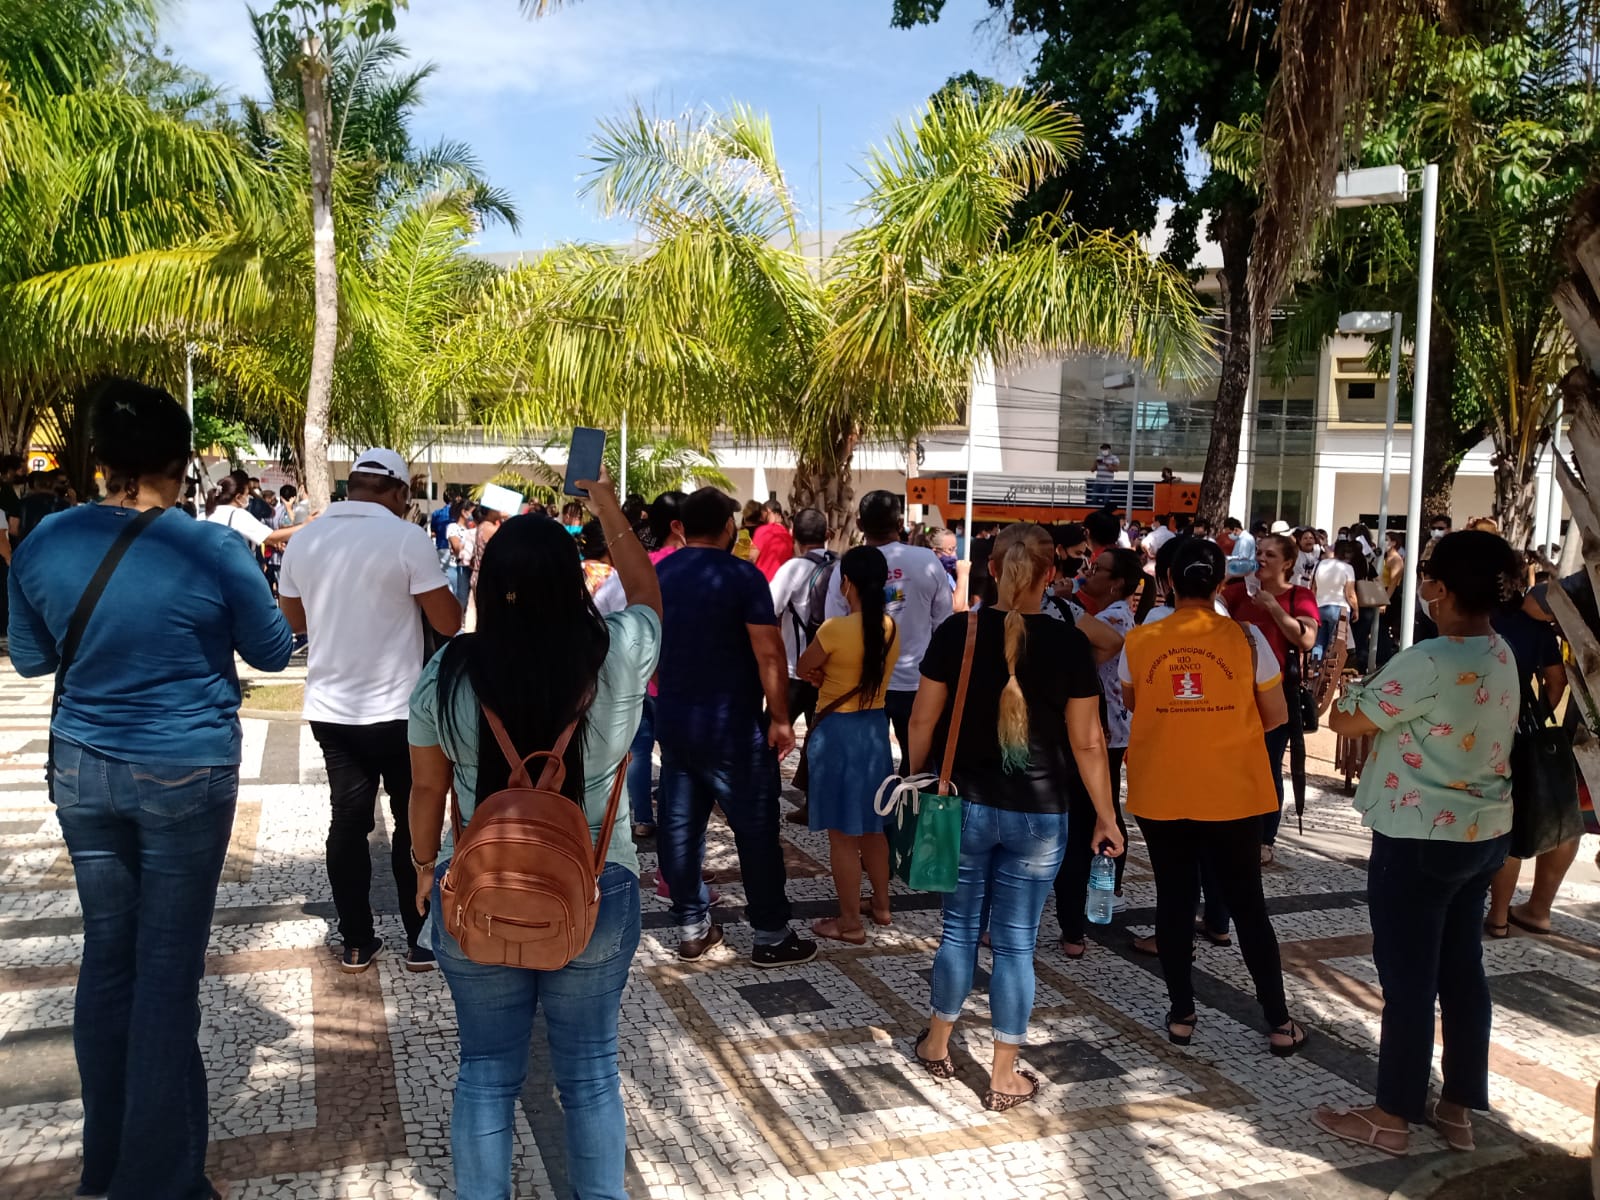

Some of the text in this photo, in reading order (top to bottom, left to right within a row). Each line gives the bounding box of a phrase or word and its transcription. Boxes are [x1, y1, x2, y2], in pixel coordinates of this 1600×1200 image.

[1168, 647, 1206, 656] Municipal
[1206, 651, 1216, 660] de
[1176, 656, 1191, 664] RIO
[1169, 663, 1201, 672] BRANCO
